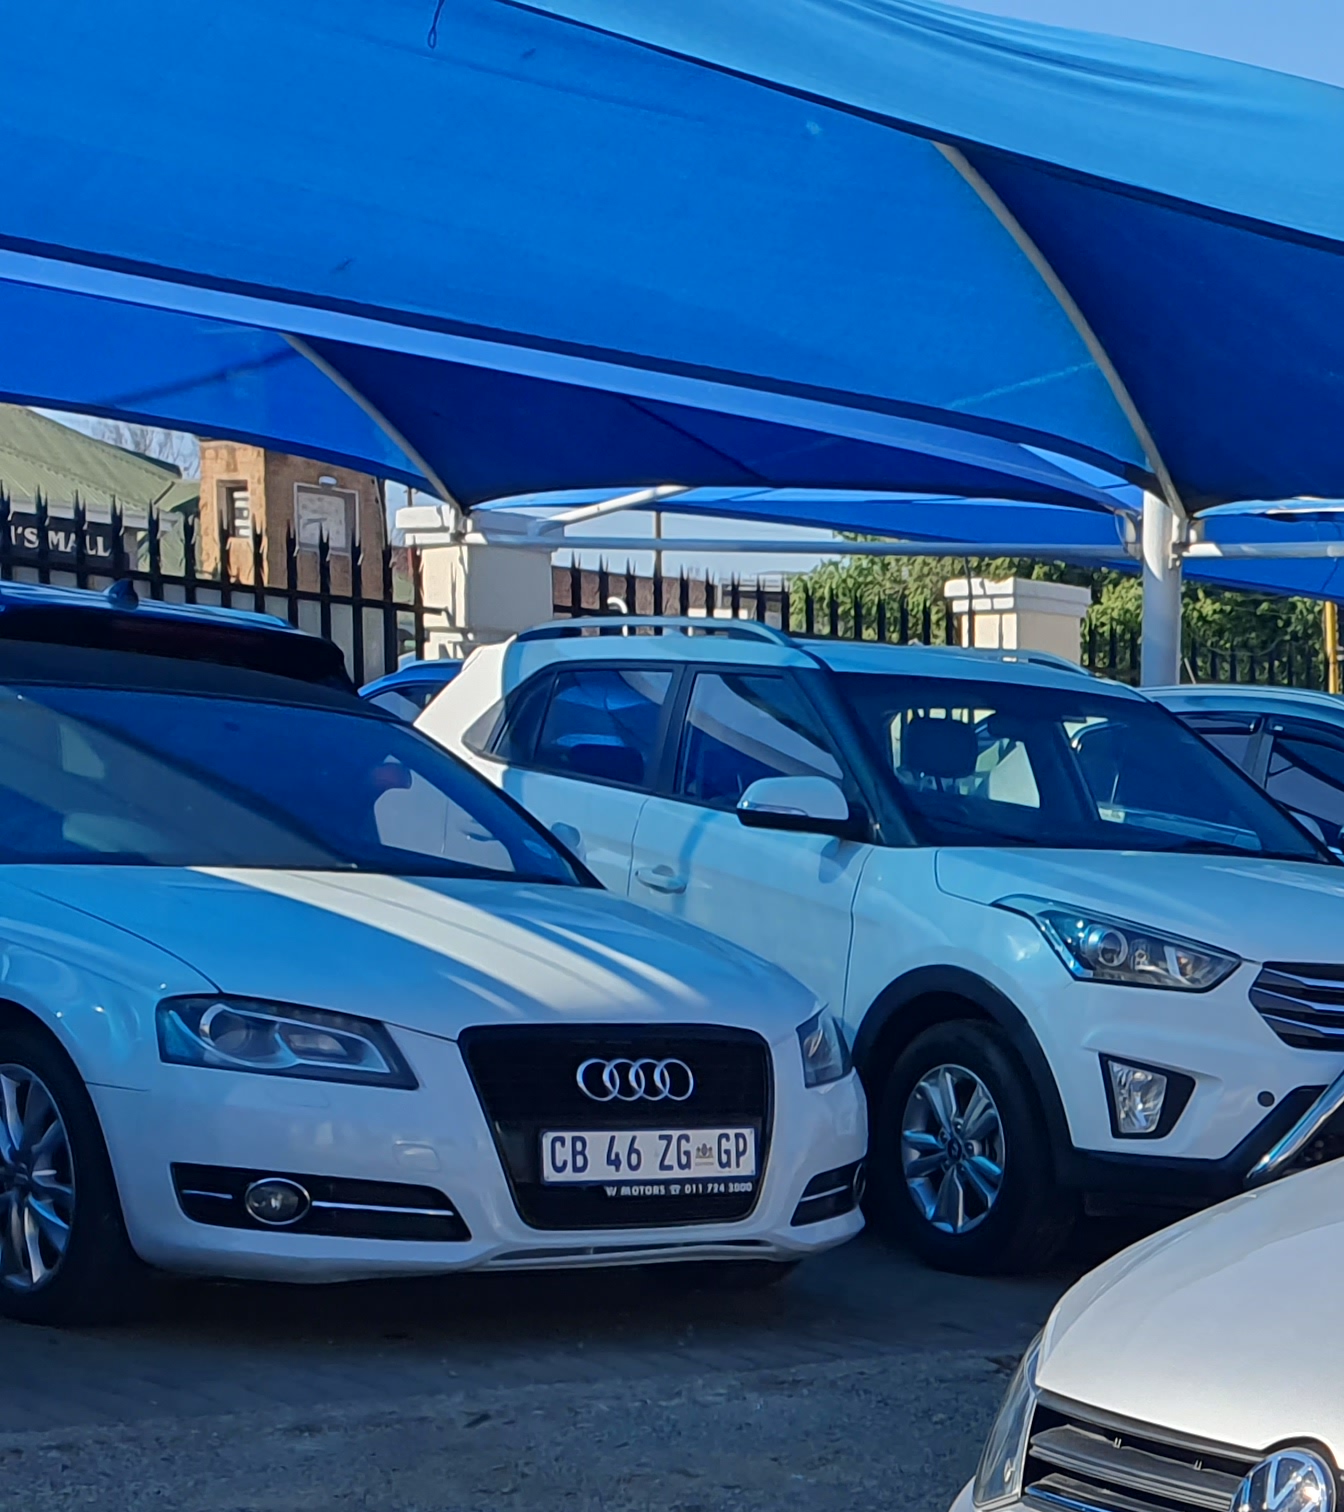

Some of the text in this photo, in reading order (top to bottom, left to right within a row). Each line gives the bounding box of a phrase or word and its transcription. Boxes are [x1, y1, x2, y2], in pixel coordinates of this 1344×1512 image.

[550, 1132, 748, 1173] CB 46 ZG GP
[620, 1184, 666, 1196] MOTORS
[684, 1184, 703, 1194] 011
[707, 1183, 725, 1193] 724
